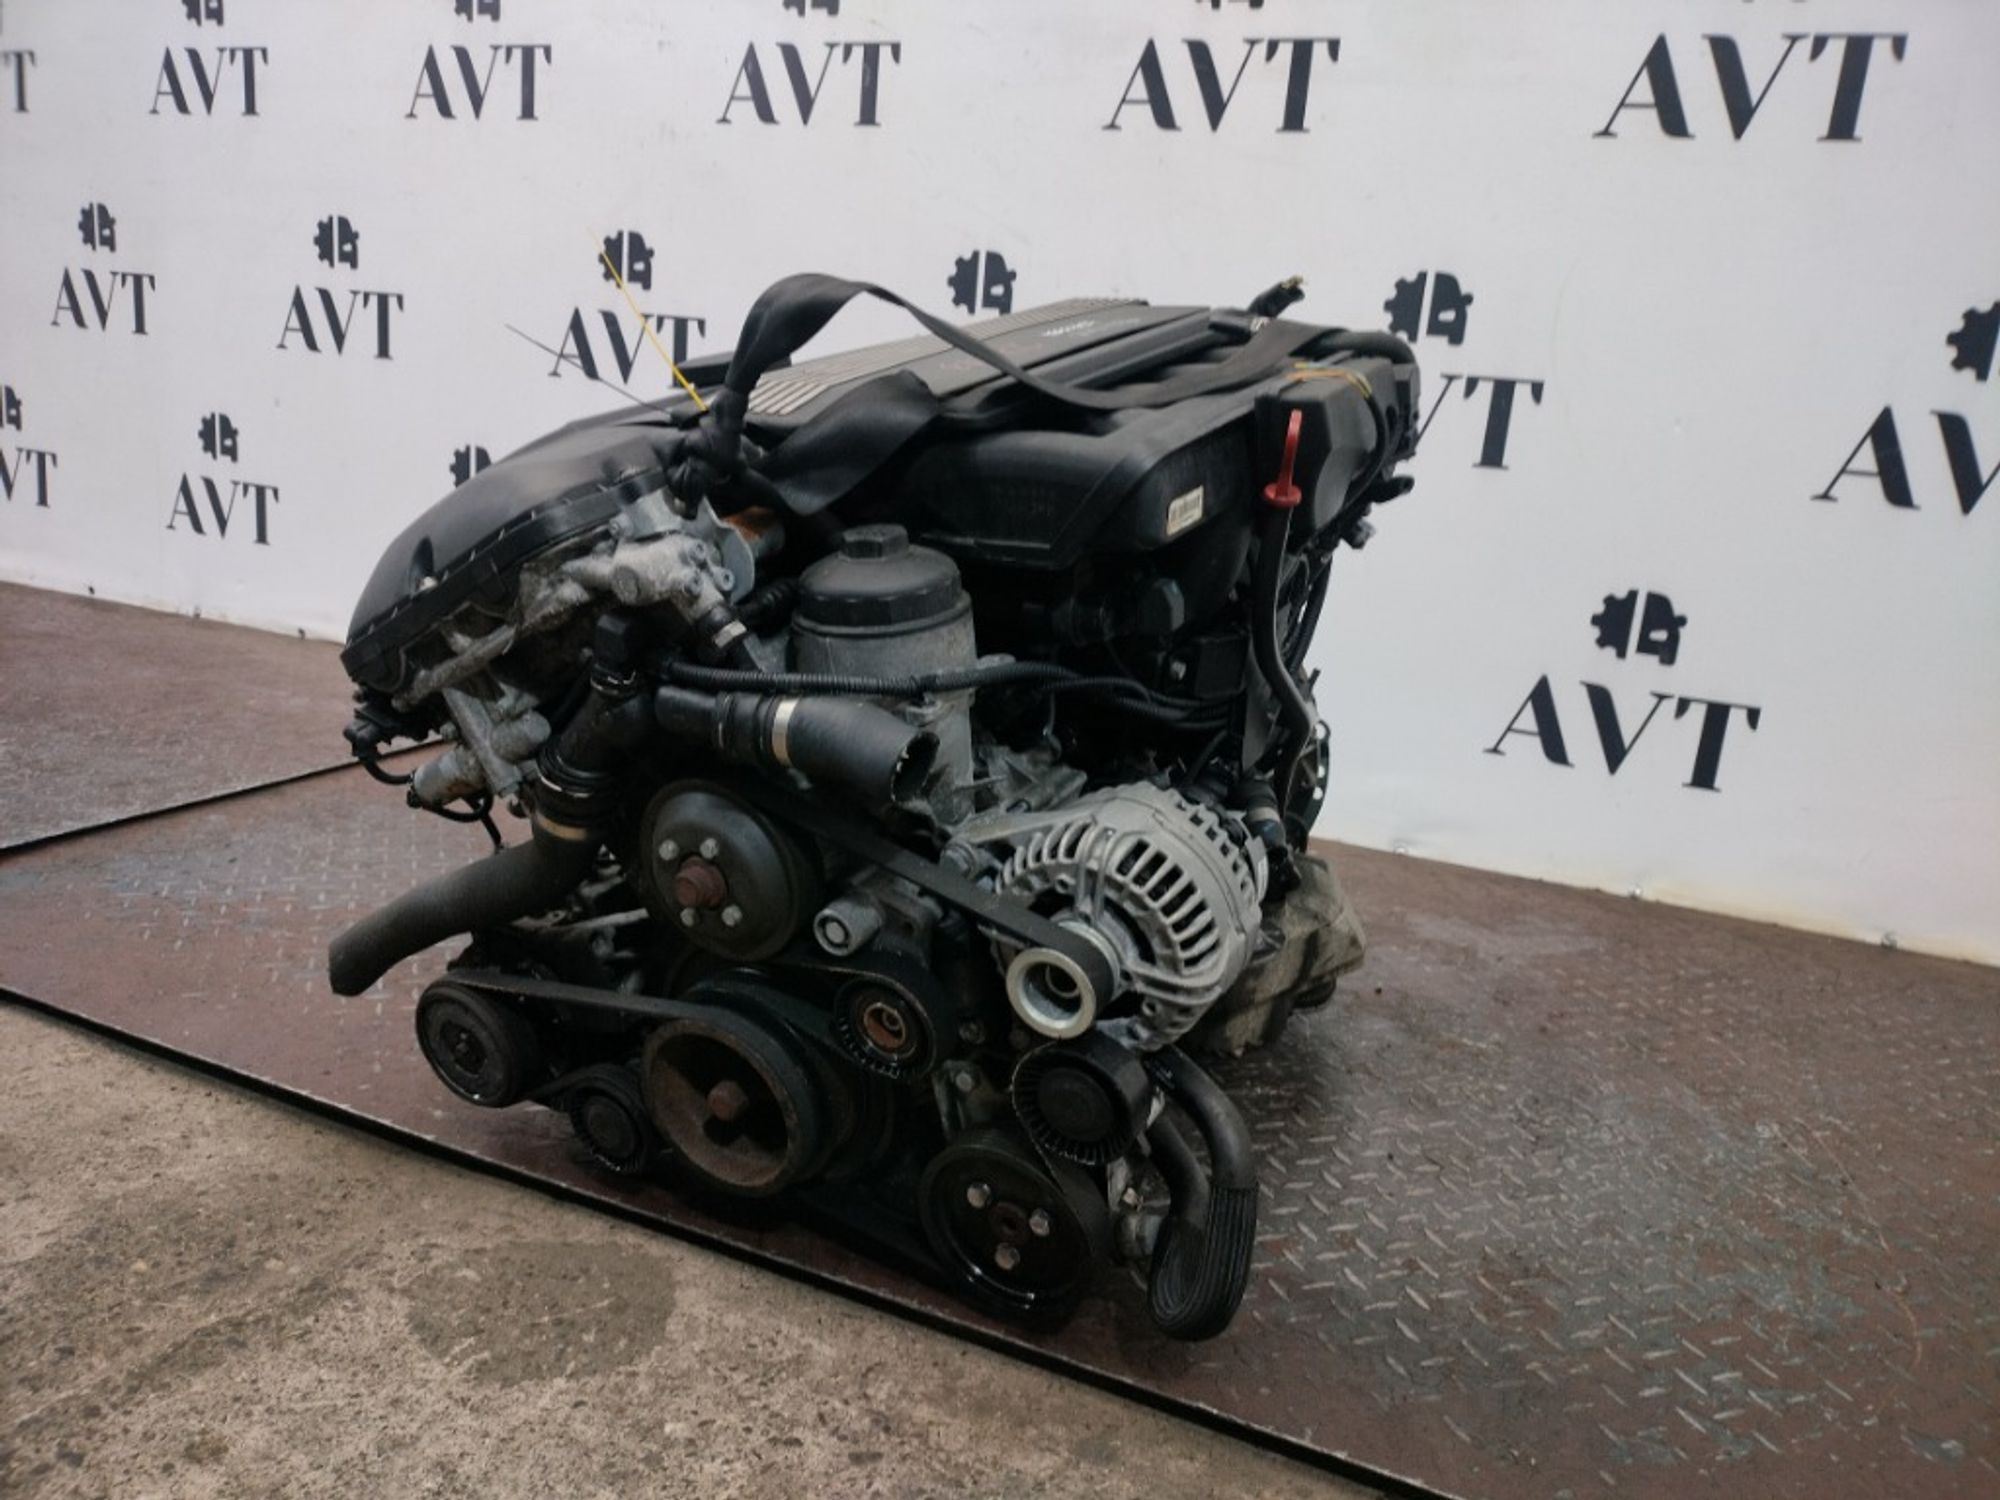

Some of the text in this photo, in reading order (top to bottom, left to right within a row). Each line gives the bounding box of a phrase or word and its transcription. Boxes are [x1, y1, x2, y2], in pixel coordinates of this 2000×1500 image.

[150, 46, 268, 116] AVT
[405, 44, 551, 120] AVT
[716, 41, 901, 126] AVT
[1102, 37, 1340, 133] AVT
[1592, 32, 1909, 142] AVT
[51, 266, 156, 335] AVT
[276, 284, 403, 360] AVT
[548, 306, 706, 389] AVT
[166, 472, 279, 545] AVT
[1483, 674, 1762, 793] AVT
